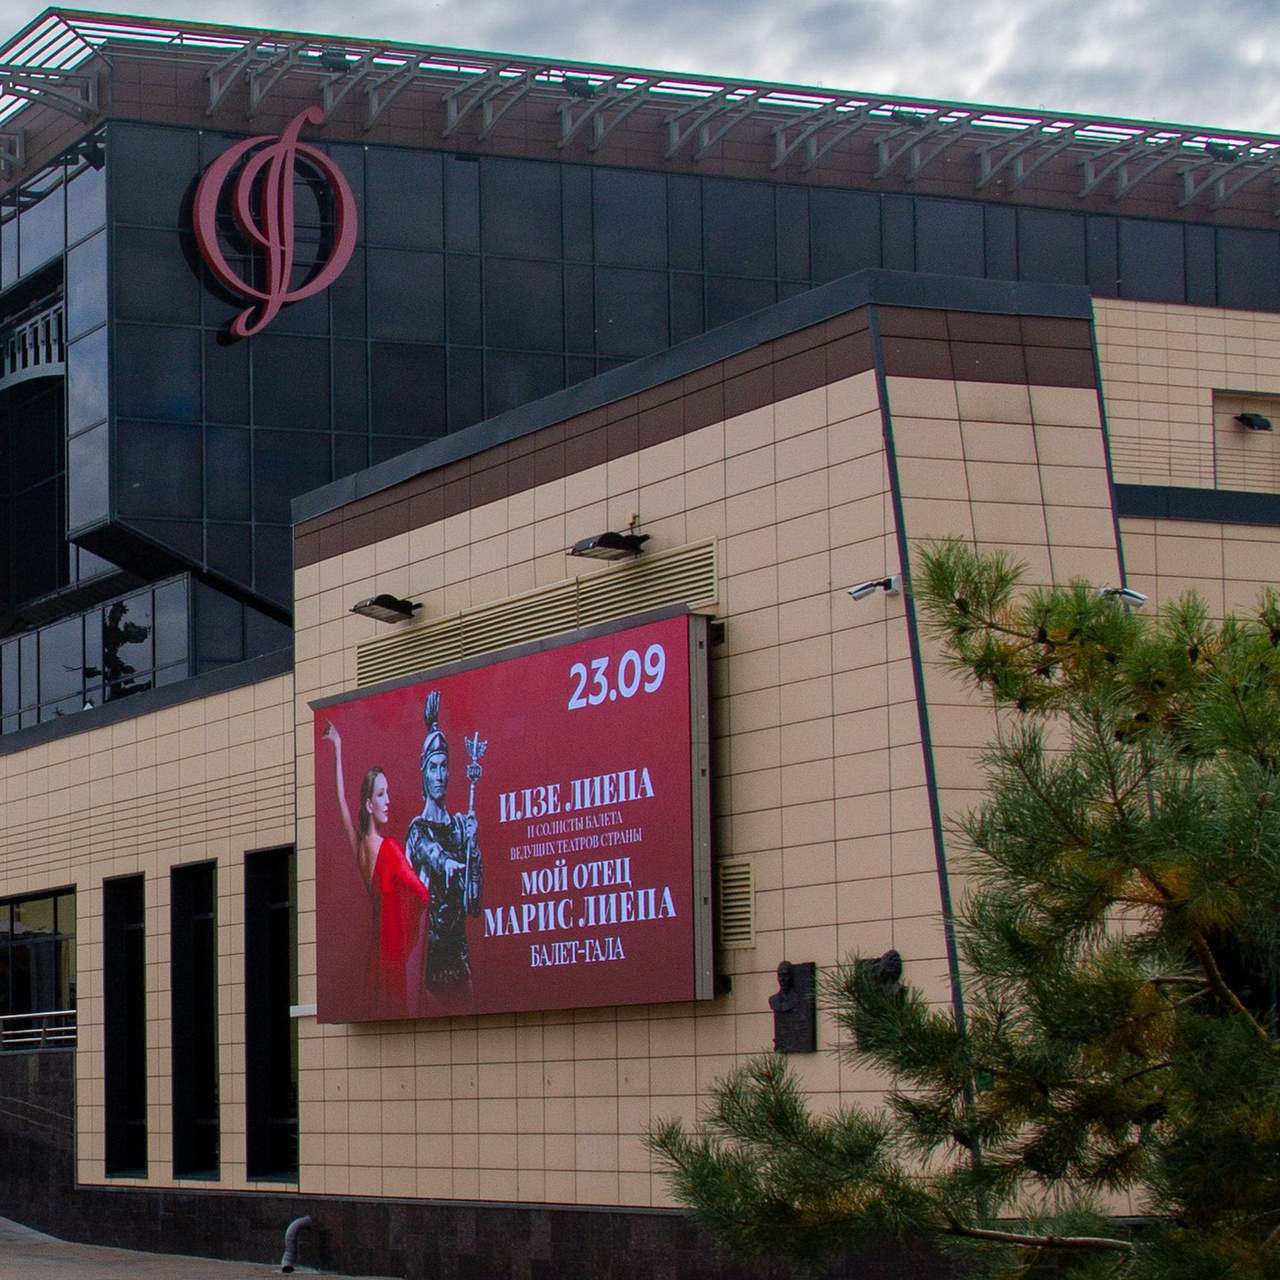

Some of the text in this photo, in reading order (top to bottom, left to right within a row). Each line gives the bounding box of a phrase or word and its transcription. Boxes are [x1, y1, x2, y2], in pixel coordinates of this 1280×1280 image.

[567, 643, 666, 711] 23.09
[498, 767, 656, 823] ИЛЗЕ ЛИЕПА
[510, 827, 643, 861] ВЕДУЩИХ ТЕАТРОВ СТРАНЫ
[527, 811, 623, 839] И СОЛИСТЫ БАЛЕТА
[521, 856, 632, 897] МОЙ ОТЕЦ
[483, 886, 677, 938] МАРИС ЛИЕПА
[530, 936, 626, 968] БАЛЕТ-ГАЛА
